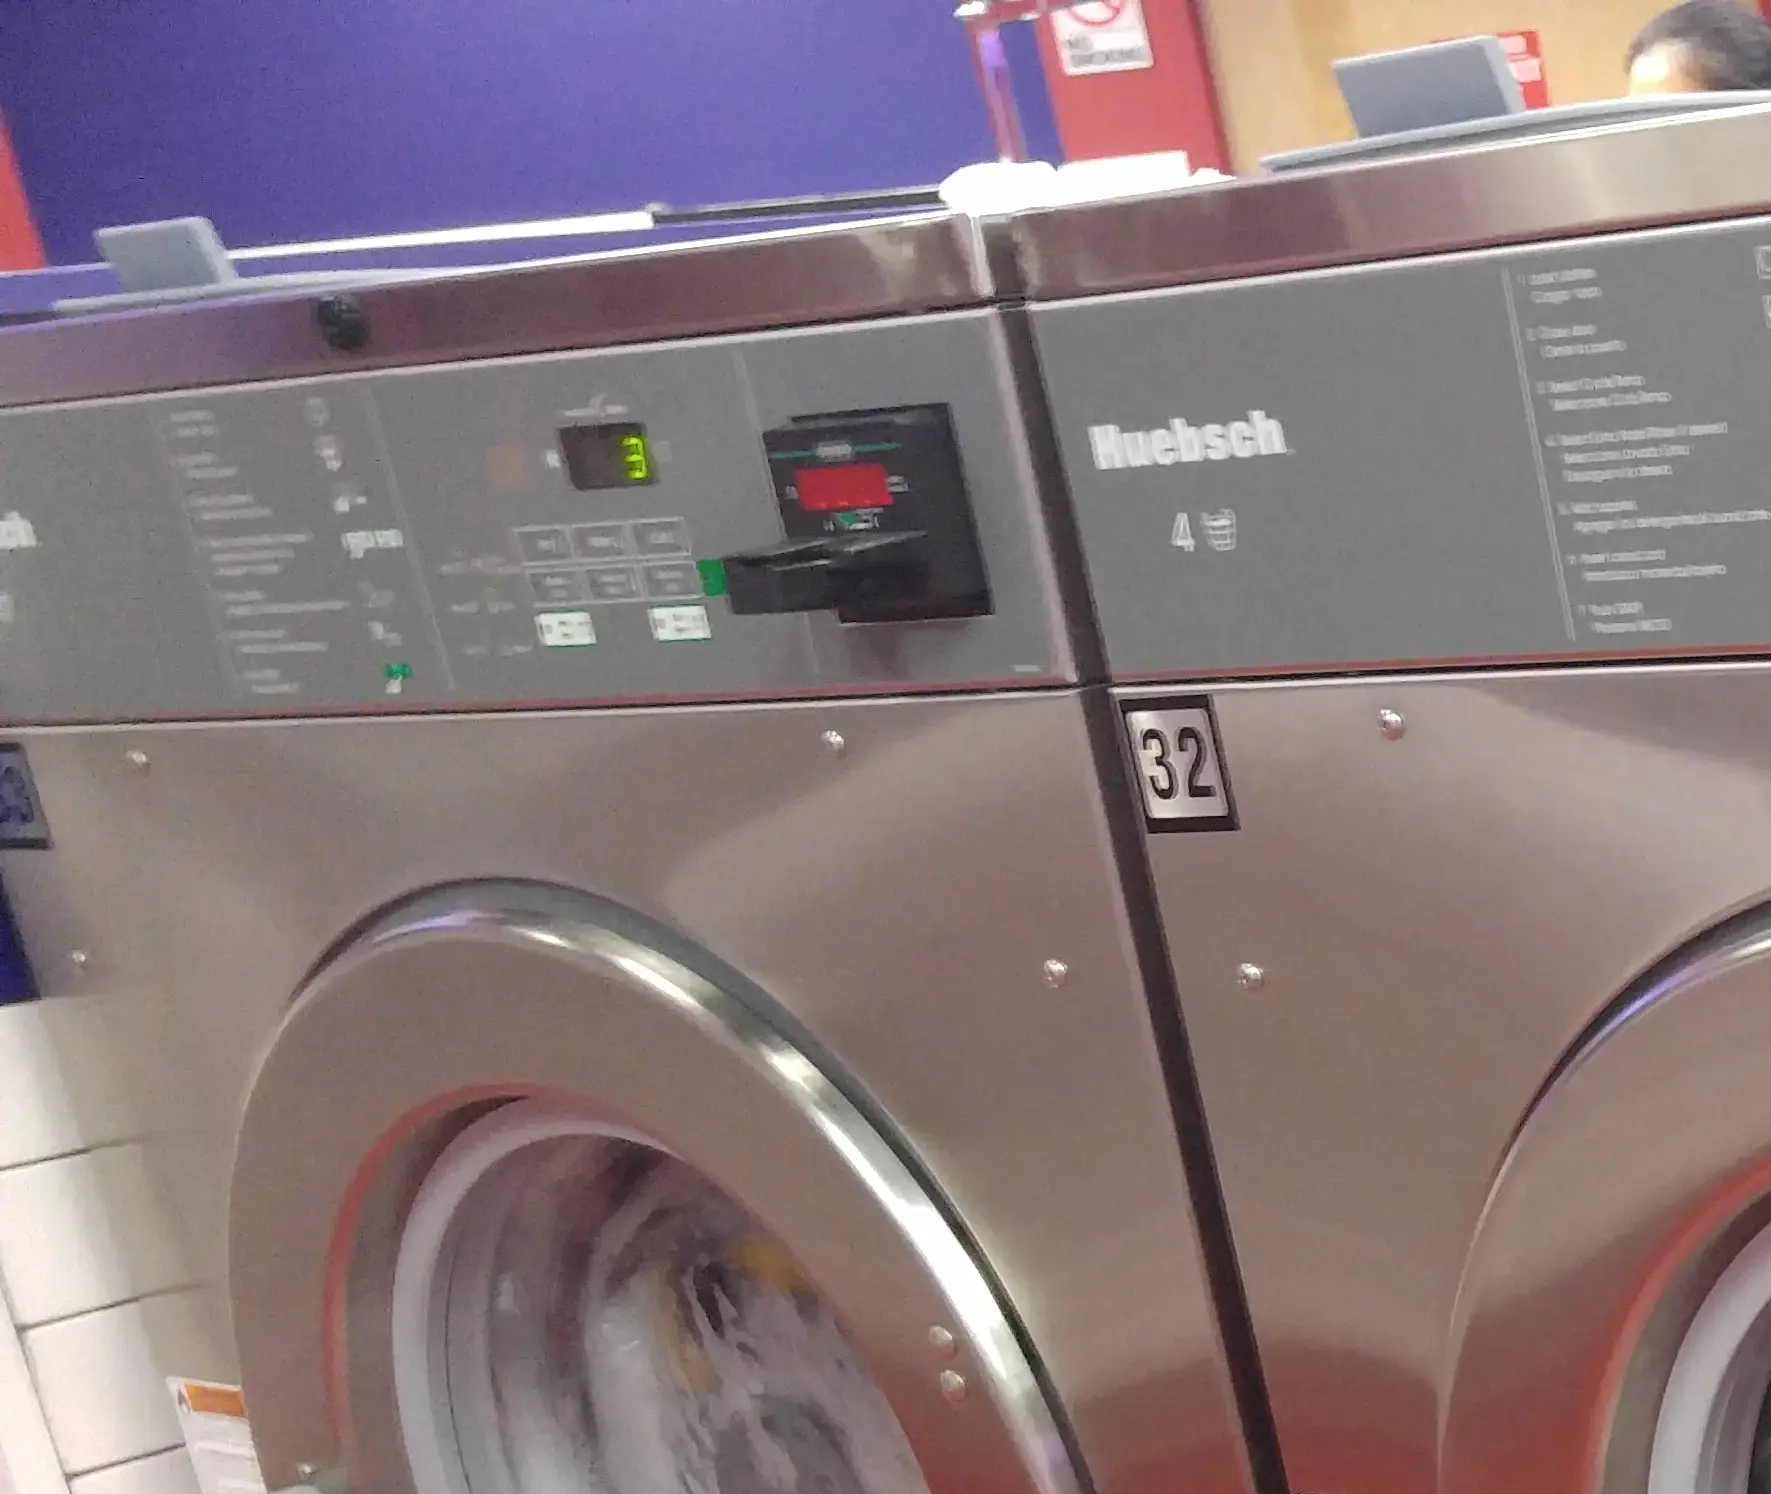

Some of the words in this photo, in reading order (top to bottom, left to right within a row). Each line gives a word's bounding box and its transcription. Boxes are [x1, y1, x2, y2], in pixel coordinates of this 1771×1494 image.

[622, 434, 648, 480] 3
[1087, 409, 1287, 470] Huebsch
[1169, 511, 1195, 552] 4
[1141, 726, 1216, 800] 32
